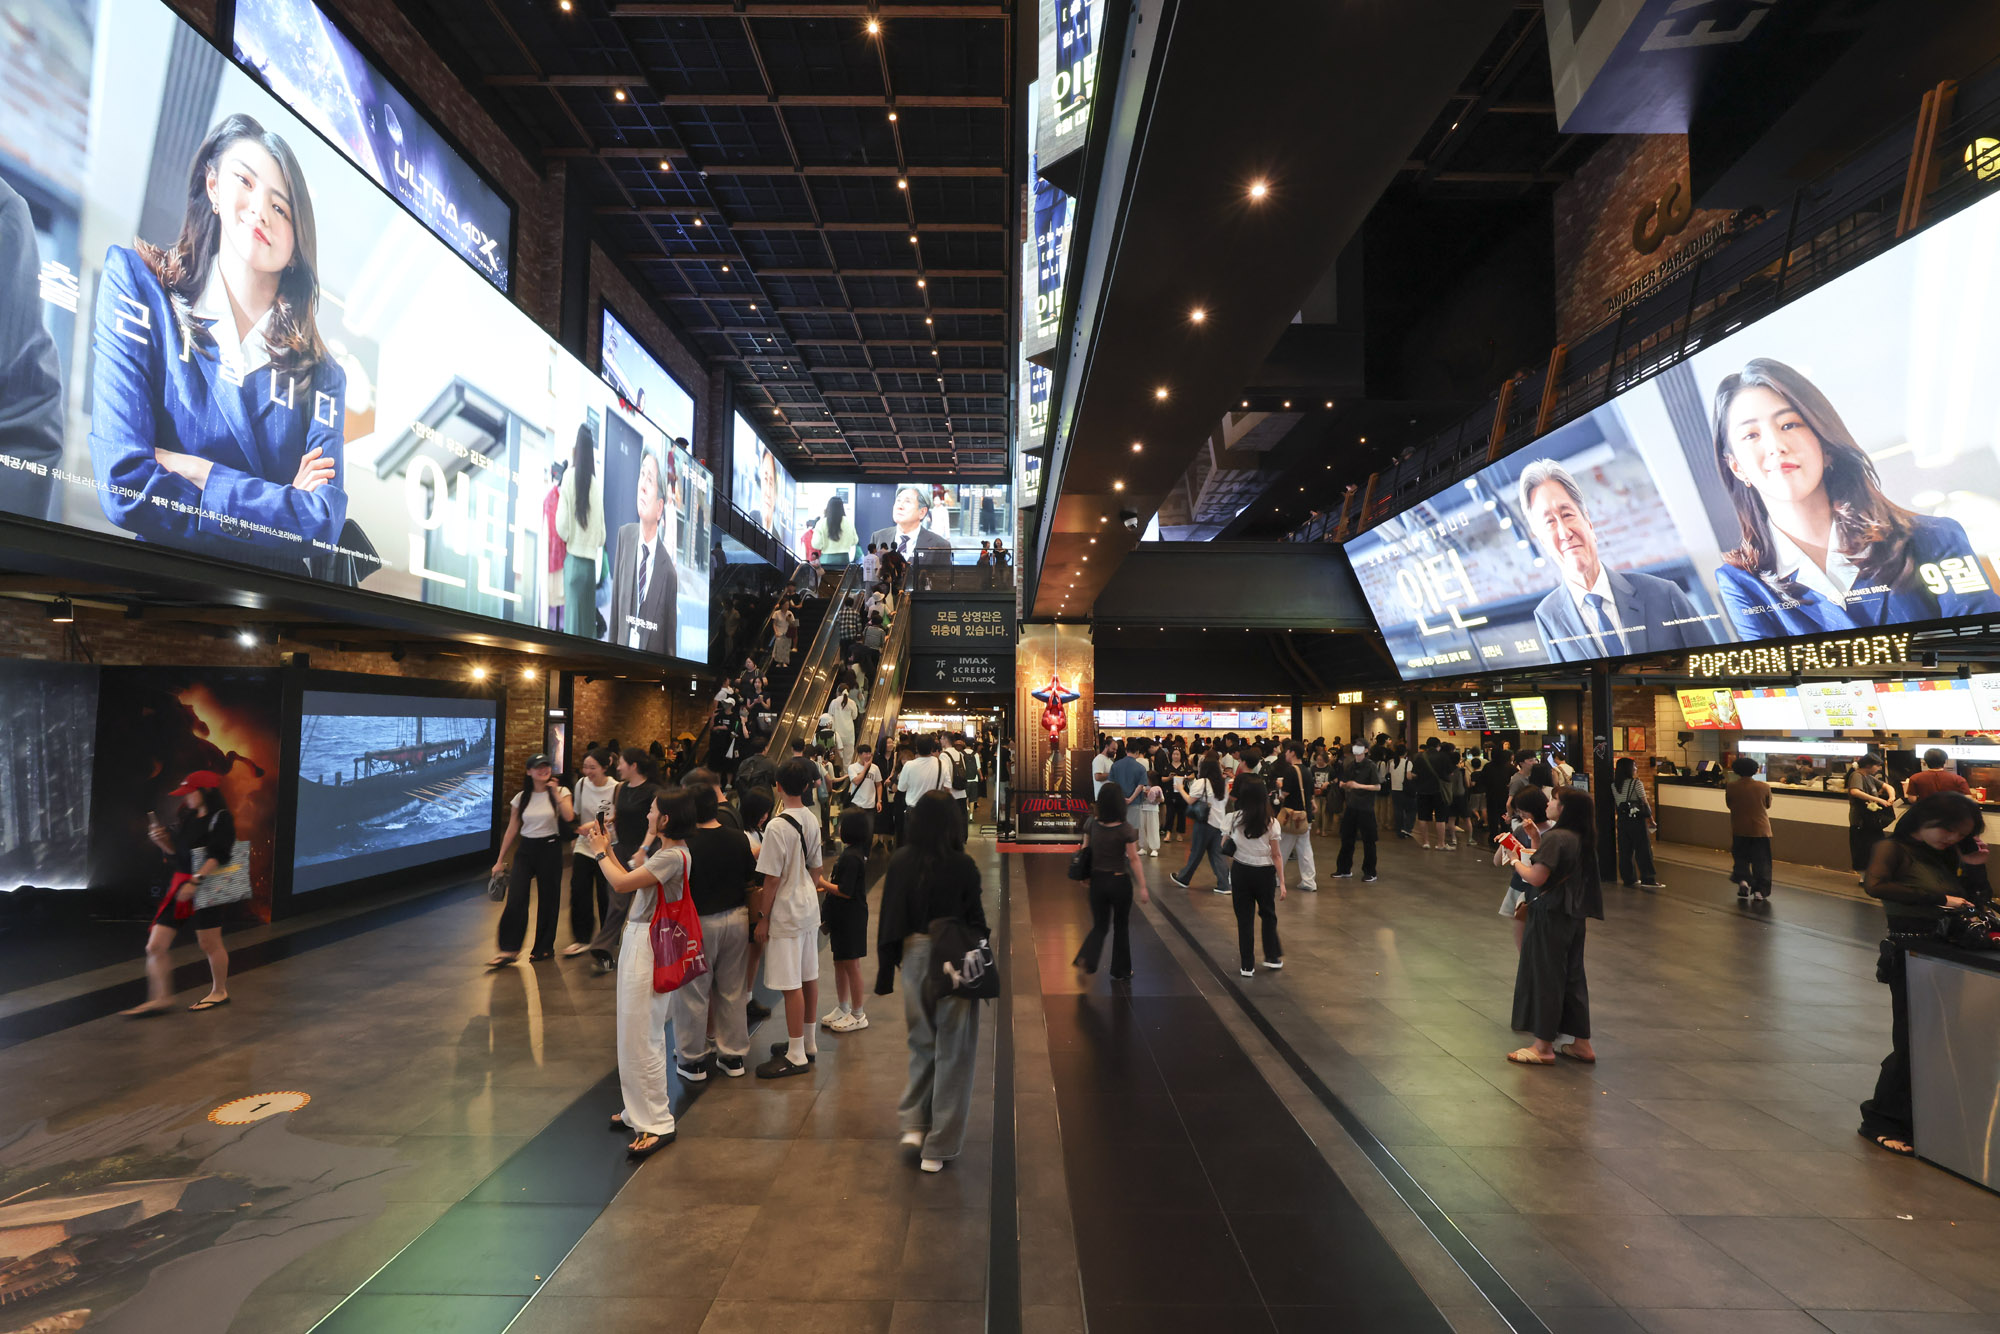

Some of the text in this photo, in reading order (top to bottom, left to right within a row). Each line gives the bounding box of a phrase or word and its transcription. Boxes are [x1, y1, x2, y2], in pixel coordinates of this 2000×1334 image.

[394, 150, 498, 271] ULTRA 4DX
[1608, 269, 1656, 313] ANOTHER
[1659, 220, 1725, 278] PARADIGM
[404, 454, 523, 604] 인턴
[1919, 555, 1989, 595] 9월
[1396, 548, 1488, 636] 인턴
[1872, 584, 1891, 593] BROS.
[937, 611, 1002, 622] 모든 상영관은
[931, 625, 1008, 636] 위층에 있습니다.
[936, 660, 946, 668] 7F
[1688, 632, 1910, 678] POPCORN FACTORY
[978, 675, 996, 684] 4DX
[1160, 706, 1202, 714] SELF ORDER
